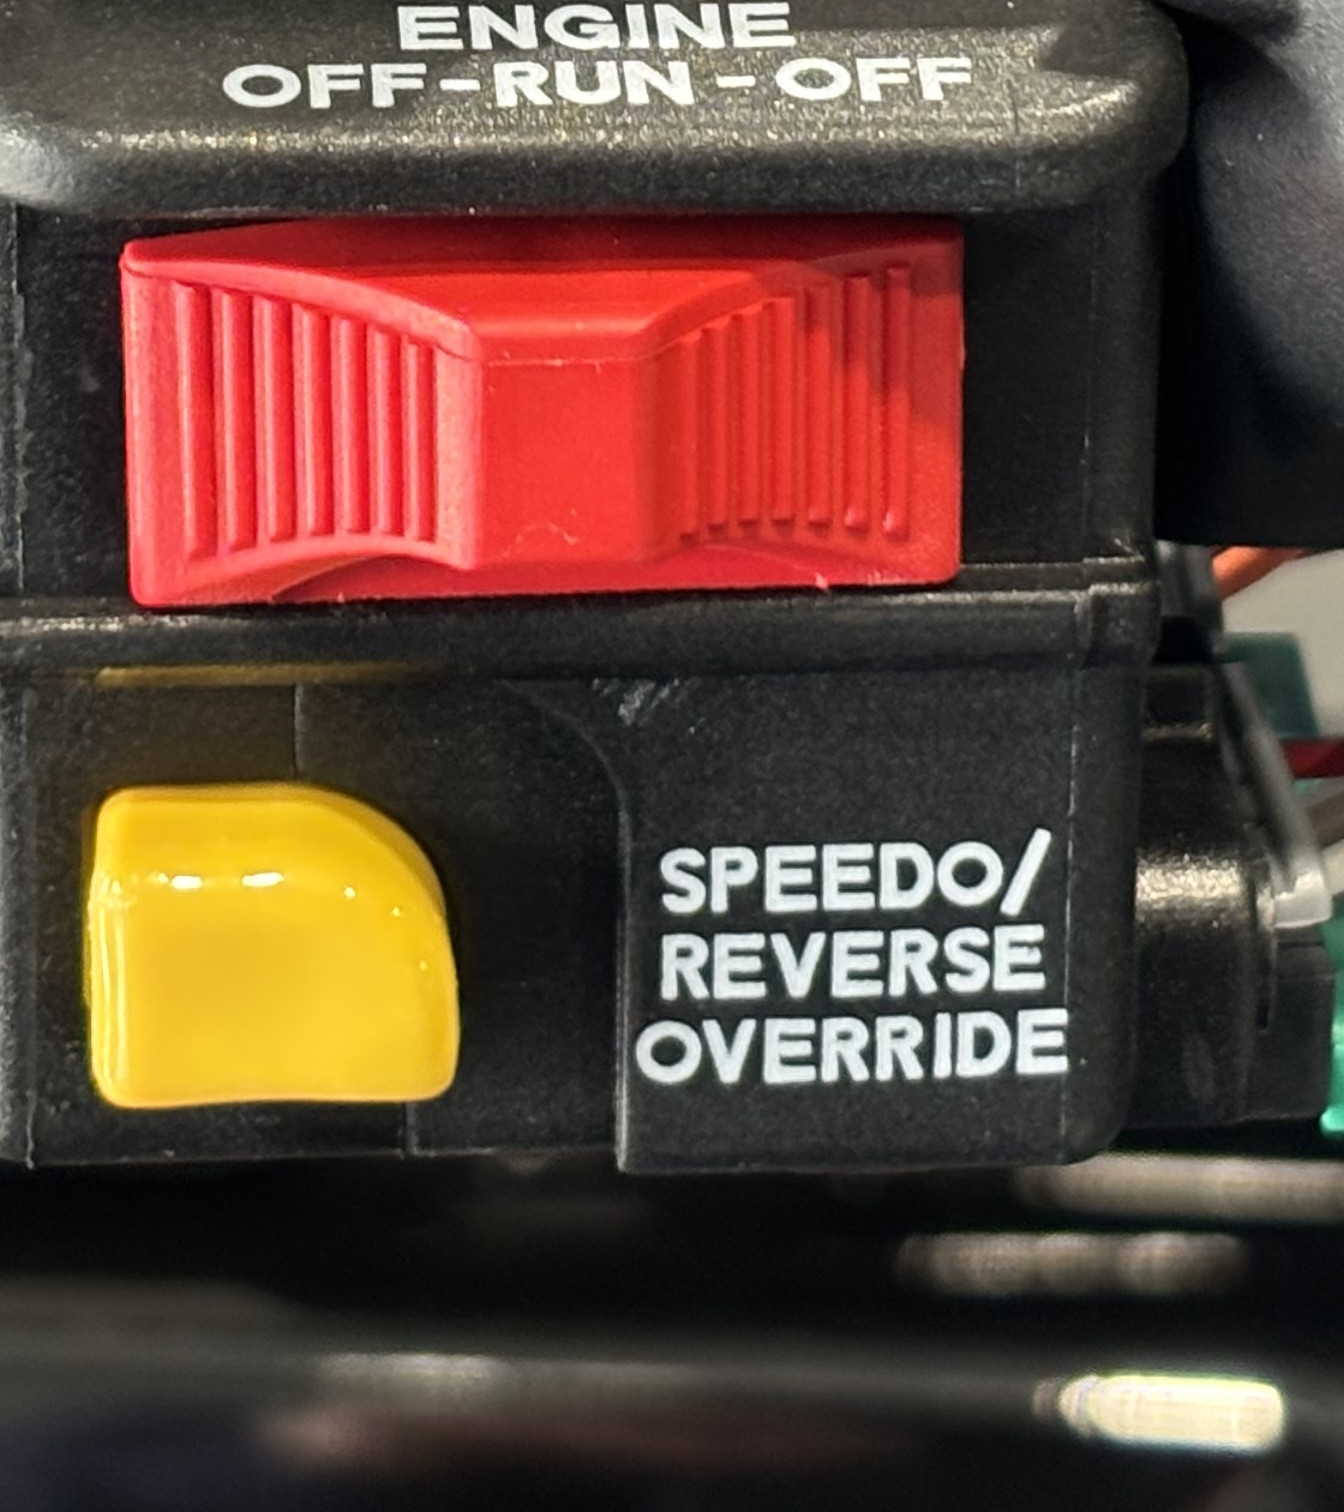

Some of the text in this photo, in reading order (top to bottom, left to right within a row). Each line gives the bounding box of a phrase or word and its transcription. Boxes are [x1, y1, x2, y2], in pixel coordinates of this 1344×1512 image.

[397, 2, 798, 52] ENGINE
[660, 828, 1053, 917] SPEEDO/
[661, 924, 1047, 1001] REVERSE
[635, 1008, 1070, 1085] OVERRIDE
